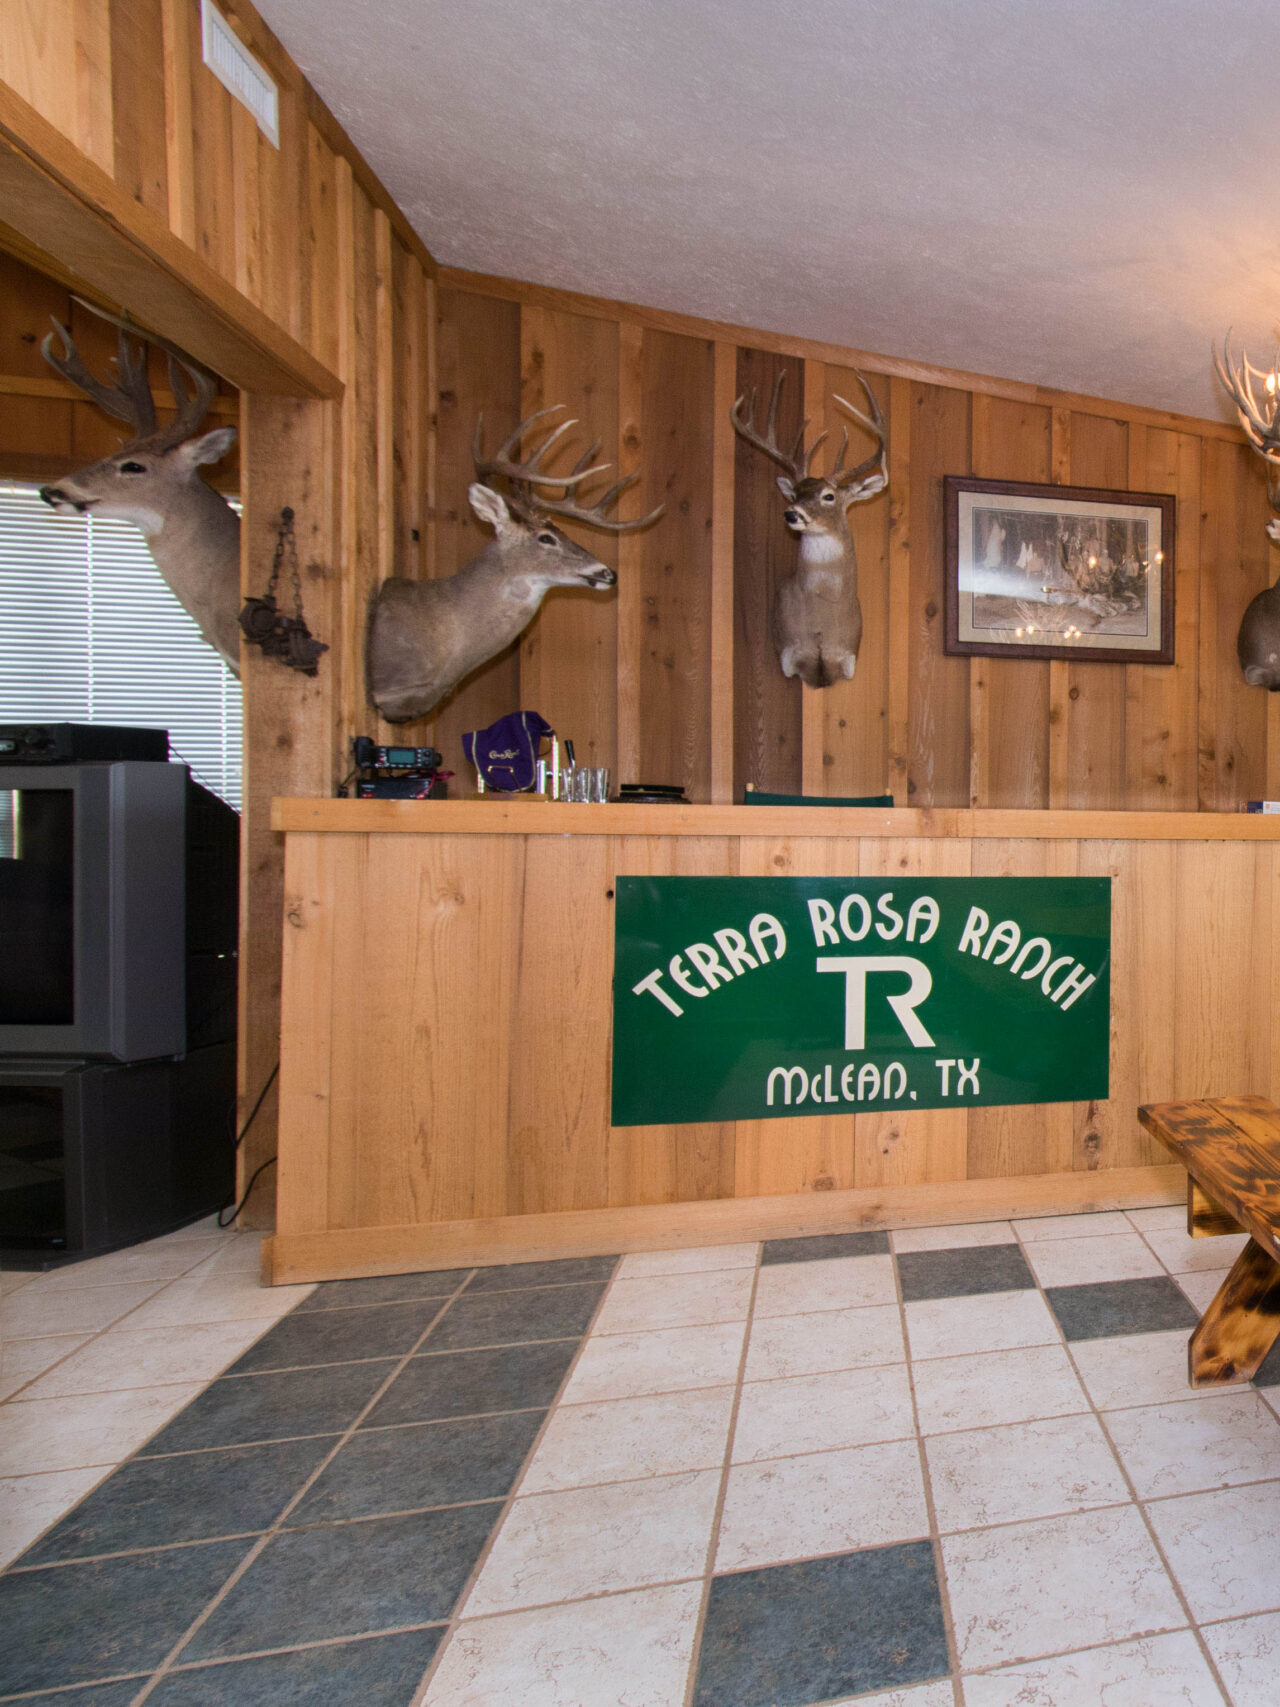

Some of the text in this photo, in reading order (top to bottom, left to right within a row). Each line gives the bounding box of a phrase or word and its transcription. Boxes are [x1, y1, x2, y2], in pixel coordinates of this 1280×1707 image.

[632, 892, 1097, 1018] TERRA ROSA RANCH
[816, 955, 937, 1051] TR
[935, 1057, 981, 1097] TX
